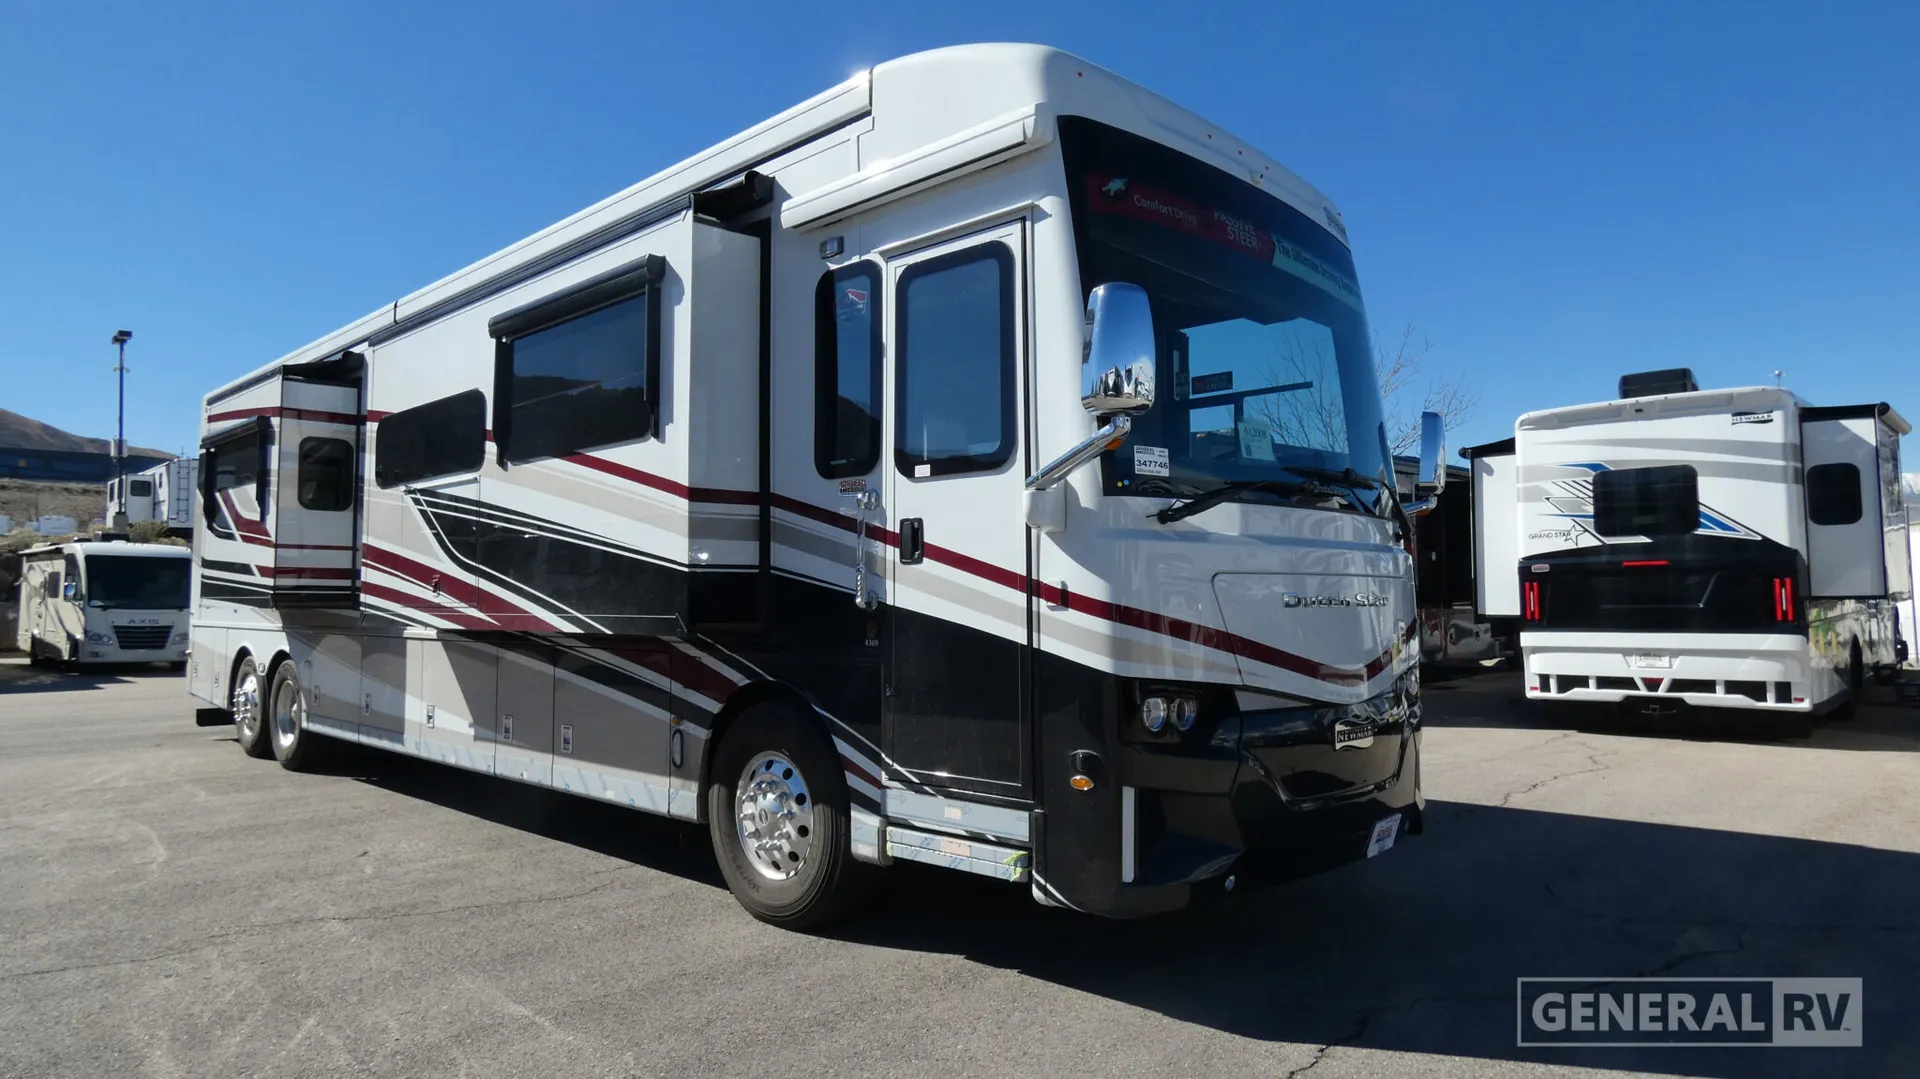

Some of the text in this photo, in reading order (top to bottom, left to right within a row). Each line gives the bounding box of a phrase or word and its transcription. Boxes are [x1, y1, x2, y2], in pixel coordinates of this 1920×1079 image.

[1133, 194, 1198, 225] Comfort Drive
[1213, 209, 1256, 236] PASSIVE
[1227, 226, 1258, 251] STEER
[1731, 413, 1772, 423] NEWMAR
[1136, 459, 1169, 470] 347746
[1528, 531, 1571, 540] GRAND STAR
[1282, 592, 1389, 609] Dutch Star
[1337, 729, 1373, 743] NEWMAR
